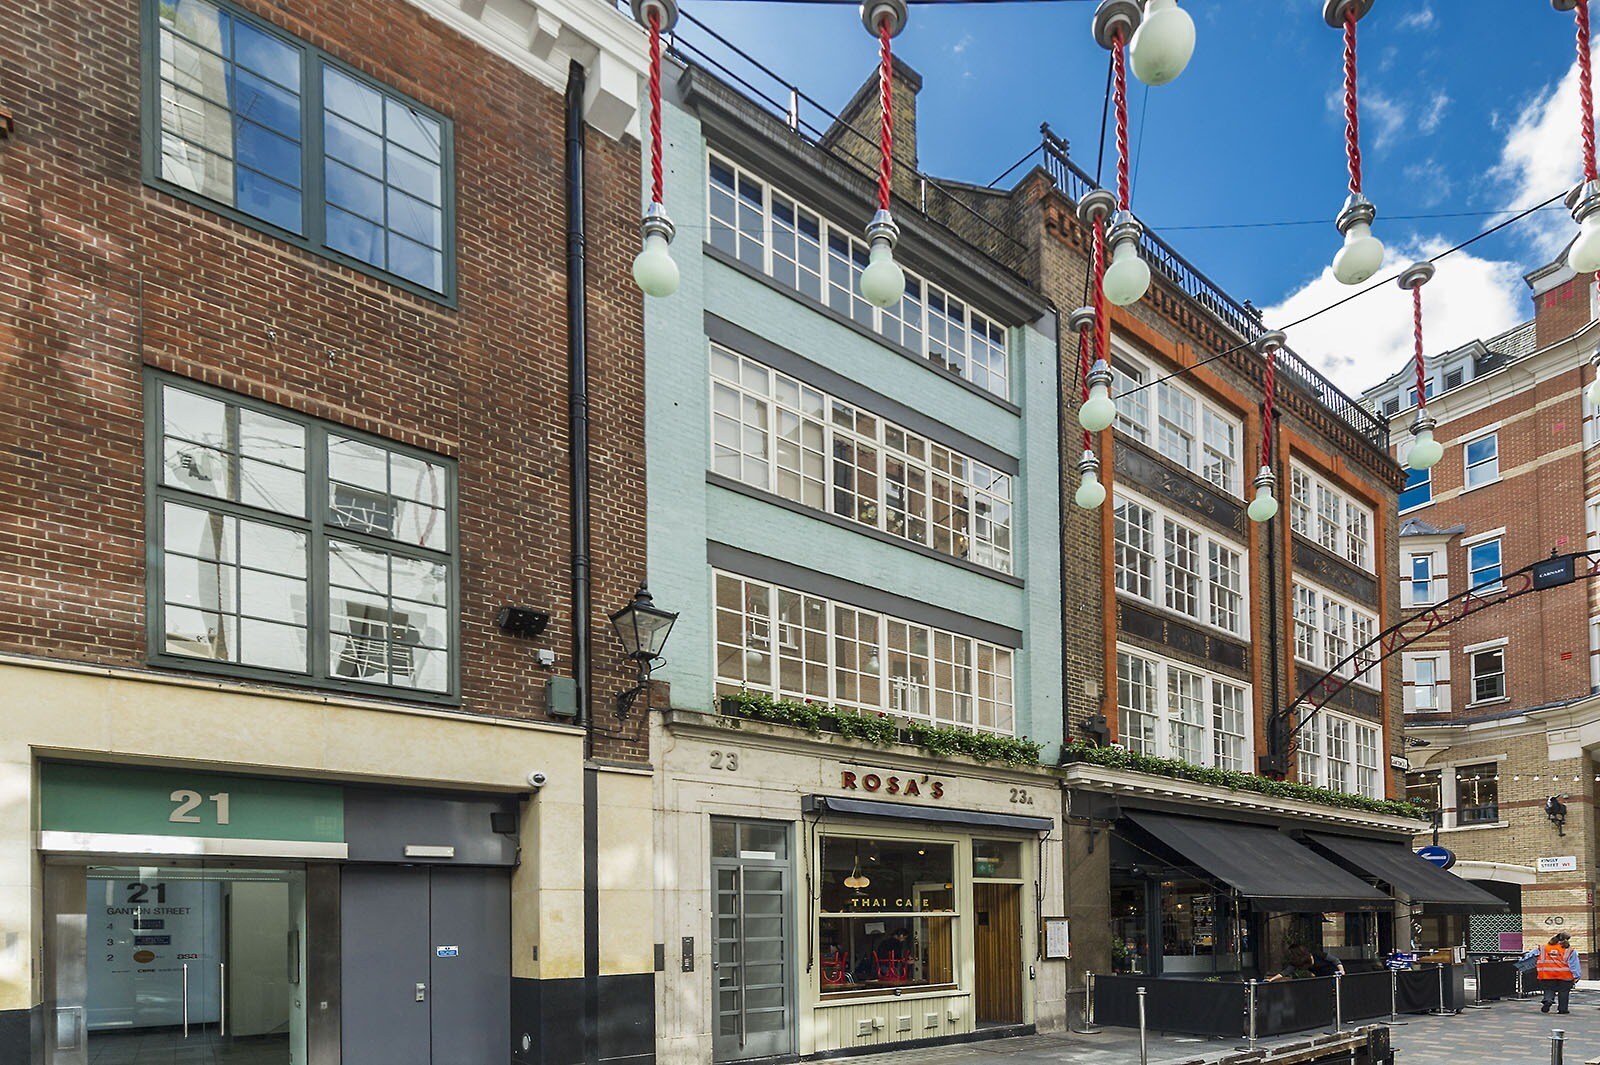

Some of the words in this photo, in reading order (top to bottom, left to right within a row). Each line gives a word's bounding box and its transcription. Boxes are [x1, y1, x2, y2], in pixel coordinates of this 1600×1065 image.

[710, 750, 738, 771] 23
[841, 771, 944, 799] ROSA'S
[169, 789, 229, 824] 21
[127, 883, 166, 903] 21
[852, 898, 887, 907] THAI
[153, 907, 191, 915] STREET
[1544, 916, 1564, 925] 60
[106, 938, 114, 946] 3
[106, 954, 114, 962] 2
